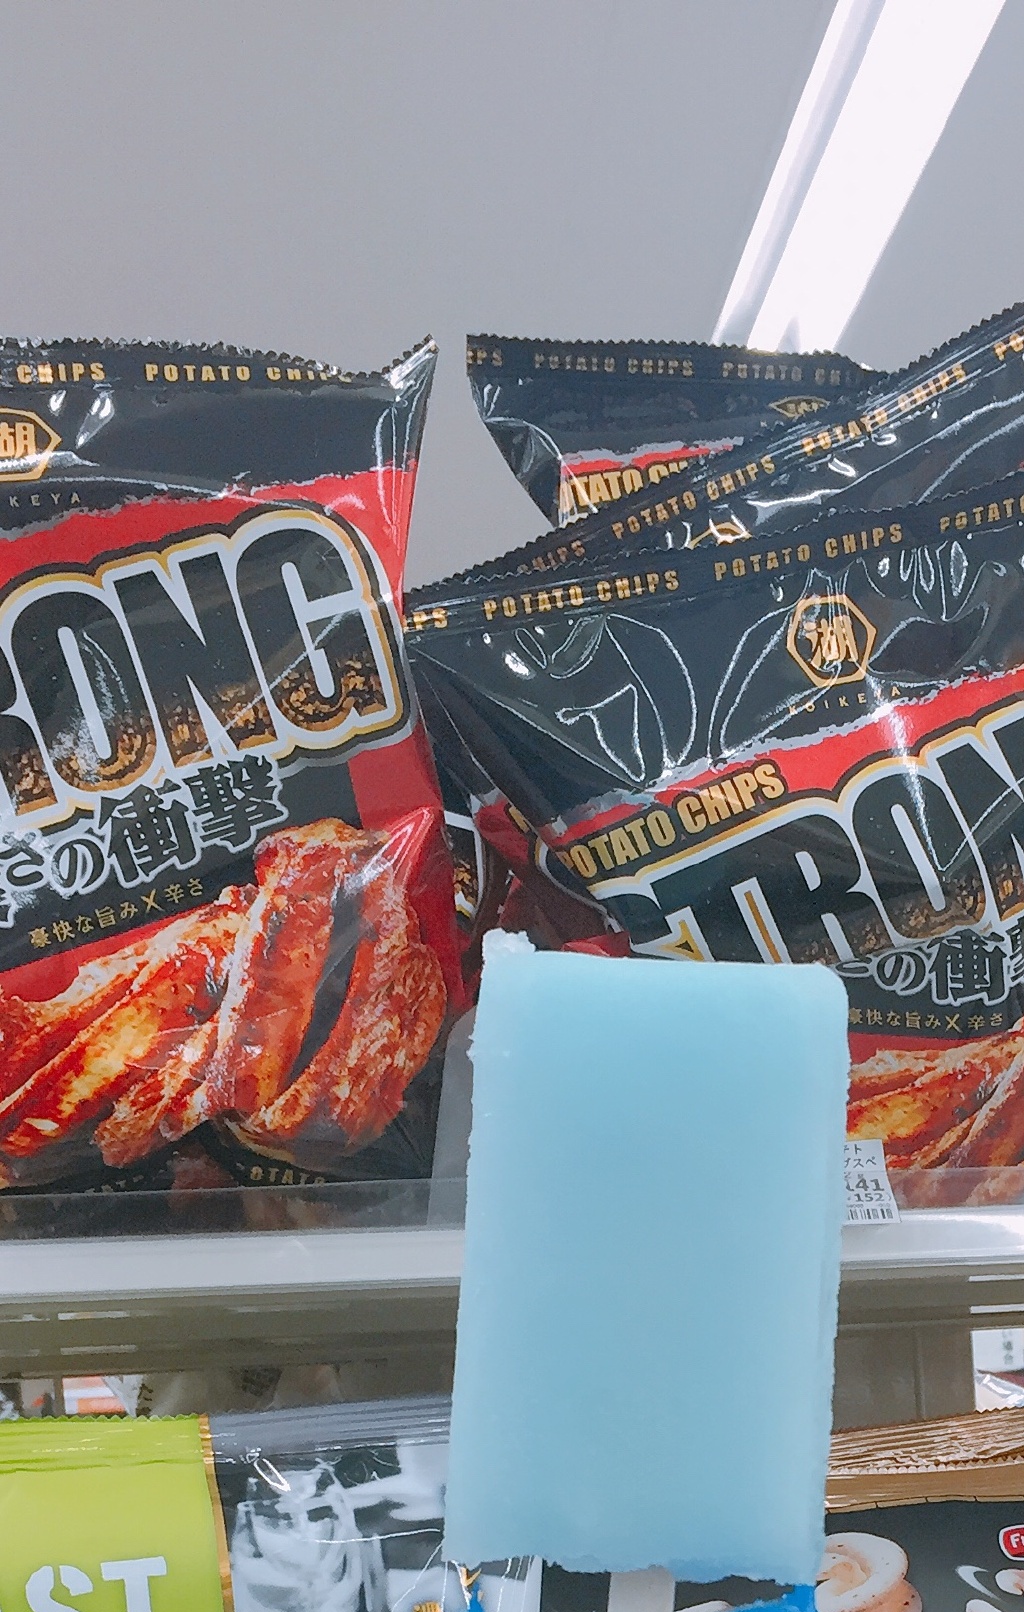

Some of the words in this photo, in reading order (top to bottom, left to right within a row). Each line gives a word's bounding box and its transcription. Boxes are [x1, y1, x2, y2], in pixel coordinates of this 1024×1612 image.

[17, 363, 106, 385] CHIPS
[145, 363, 251, 382] POTATO
[722, 361, 803, 382] POTATO
[611, 490, 698, 541] POTATO
[707, 454, 777, 501] CHIPS
[801, 407, 889, 457] POTATO
[897, 362, 968, 412] CHIPS
[484, 584, 586, 621] POTATO
[596, 570, 680, 601] CHIPS
[714, 543, 812, 581] POTATO
[825, 521, 904, 559] CHIPS
[0, 525, 396, 815] ONG
[677, 764, 786, 836] CHIPS
